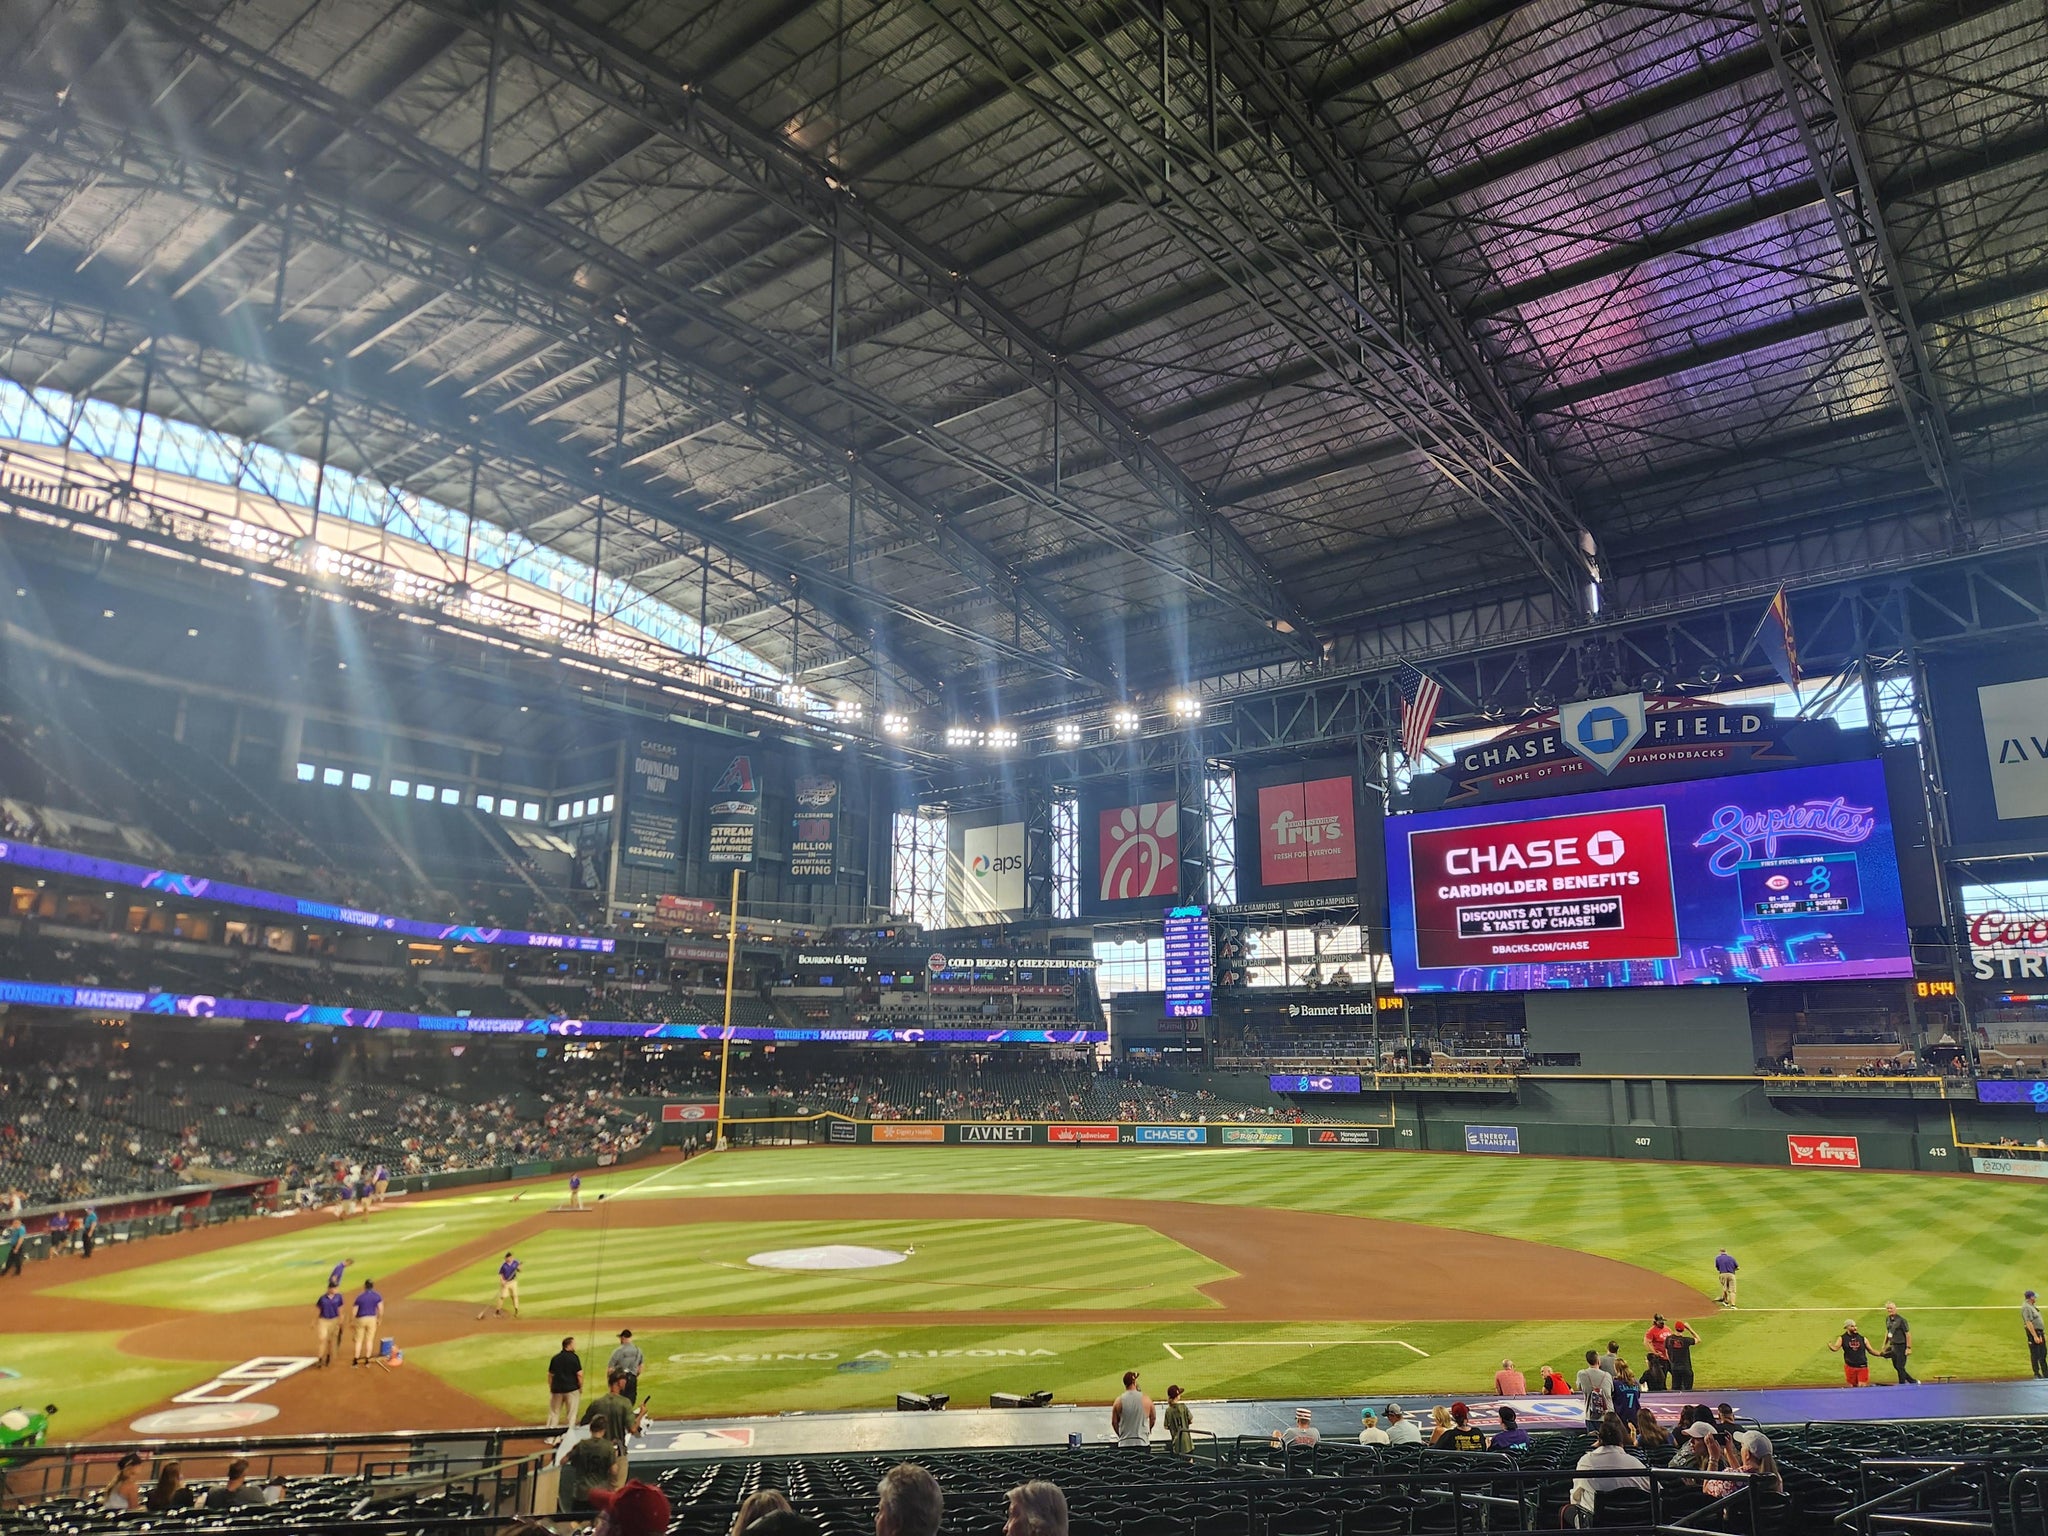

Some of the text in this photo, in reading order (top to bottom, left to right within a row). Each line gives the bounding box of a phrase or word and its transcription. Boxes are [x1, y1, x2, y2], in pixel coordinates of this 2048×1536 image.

[640, 740, 677, 756] CAESARS
[1464, 715, 1762, 772] CHASE FIELD
[635, 758, 680, 781] DOWNLOAD
[1498, 749, 1725, 785] HOME OF THE DIAMONDBACKS
[646, 776, 667, 793] NOW
[710, 827, 754, 836] STREAM
[1270, 810, 1342, 845] fry's
[710, 837, 753, 845] ANY GAME
[1692, 797, 1875, 877] Serpientes
[792, 842, 833, 851] MILLION
[1274, 847, 1342, 860] FRESH FOR EVERYONE
[1446, 837, 1581, 875] CHASE
[791, 866, 832, 876] GIVING
[992, 855, 1022, 875] aps
[1438, 871, 1641, 900] CARDHOLDER BENEFITS
[1217, 902, 1280, 914] NL WEST CHAMPIONS
[1293, 896, 1355, 908] WORLD CHAMPIONS
[340, 908, 380, 928] MATCHUP
[1462, 902, 1618, 923] DISCOUNTS AT TEAM SHOP
[1482, 915, 1596, 932] & TASTE OF CHASE!
[1491, 941, 1590, 955] DBACKS.COM/CHASE
[798, 954, 867, 965] BOURBON & BONES
[948, 958, 974, 968] COLD
[976, 958, 1008, 968] BEERS
[1009, 959, 1016, 968] &
[1017, 959, 1101, 969] CHEESEBURGERS
[1231, 957, 1266, 968] WILD CARD
[1301, 954, 1353, 964] NL CHAMPIONS
[1972, 953, 2048, 980] STR
[75, 989, 146, 1010] MATCHUP
[1174, 1005, 1203, 1016] $3,942
[1300, 1004, 1339, 1016] Banner
[467, 1018, 524, 1033] MATCHUP
[773, 1029, 820, 1040] TONIGHT'S
[820, 1030, 869, 1040] MATCHUP
[968, 1126, 1025, 1141] AVNET
[1121, 1135, 1134, 1143] 374
[1144, 1130, 1185, 1140] CHASE
[1340, 1131, 1368, 1139] Honeywell
[1401, 1129, 1413, 1137] 413
[1479, 1132, 1508, 1140] ENERGY
[1480, 1139, 1517, 1147] TRANSFER
[1635, 1136, 1651, 1147] 407
[1815, 1141, 1857, 1161] fry's
[1929, 1147, 1947, 1157] 413
[1991, 1162, 2012, 1173] zoyo
[668, 1348, 1058, 1363] CASINO ARIZONA
[1626, 1392, 1635, 1409] 7
